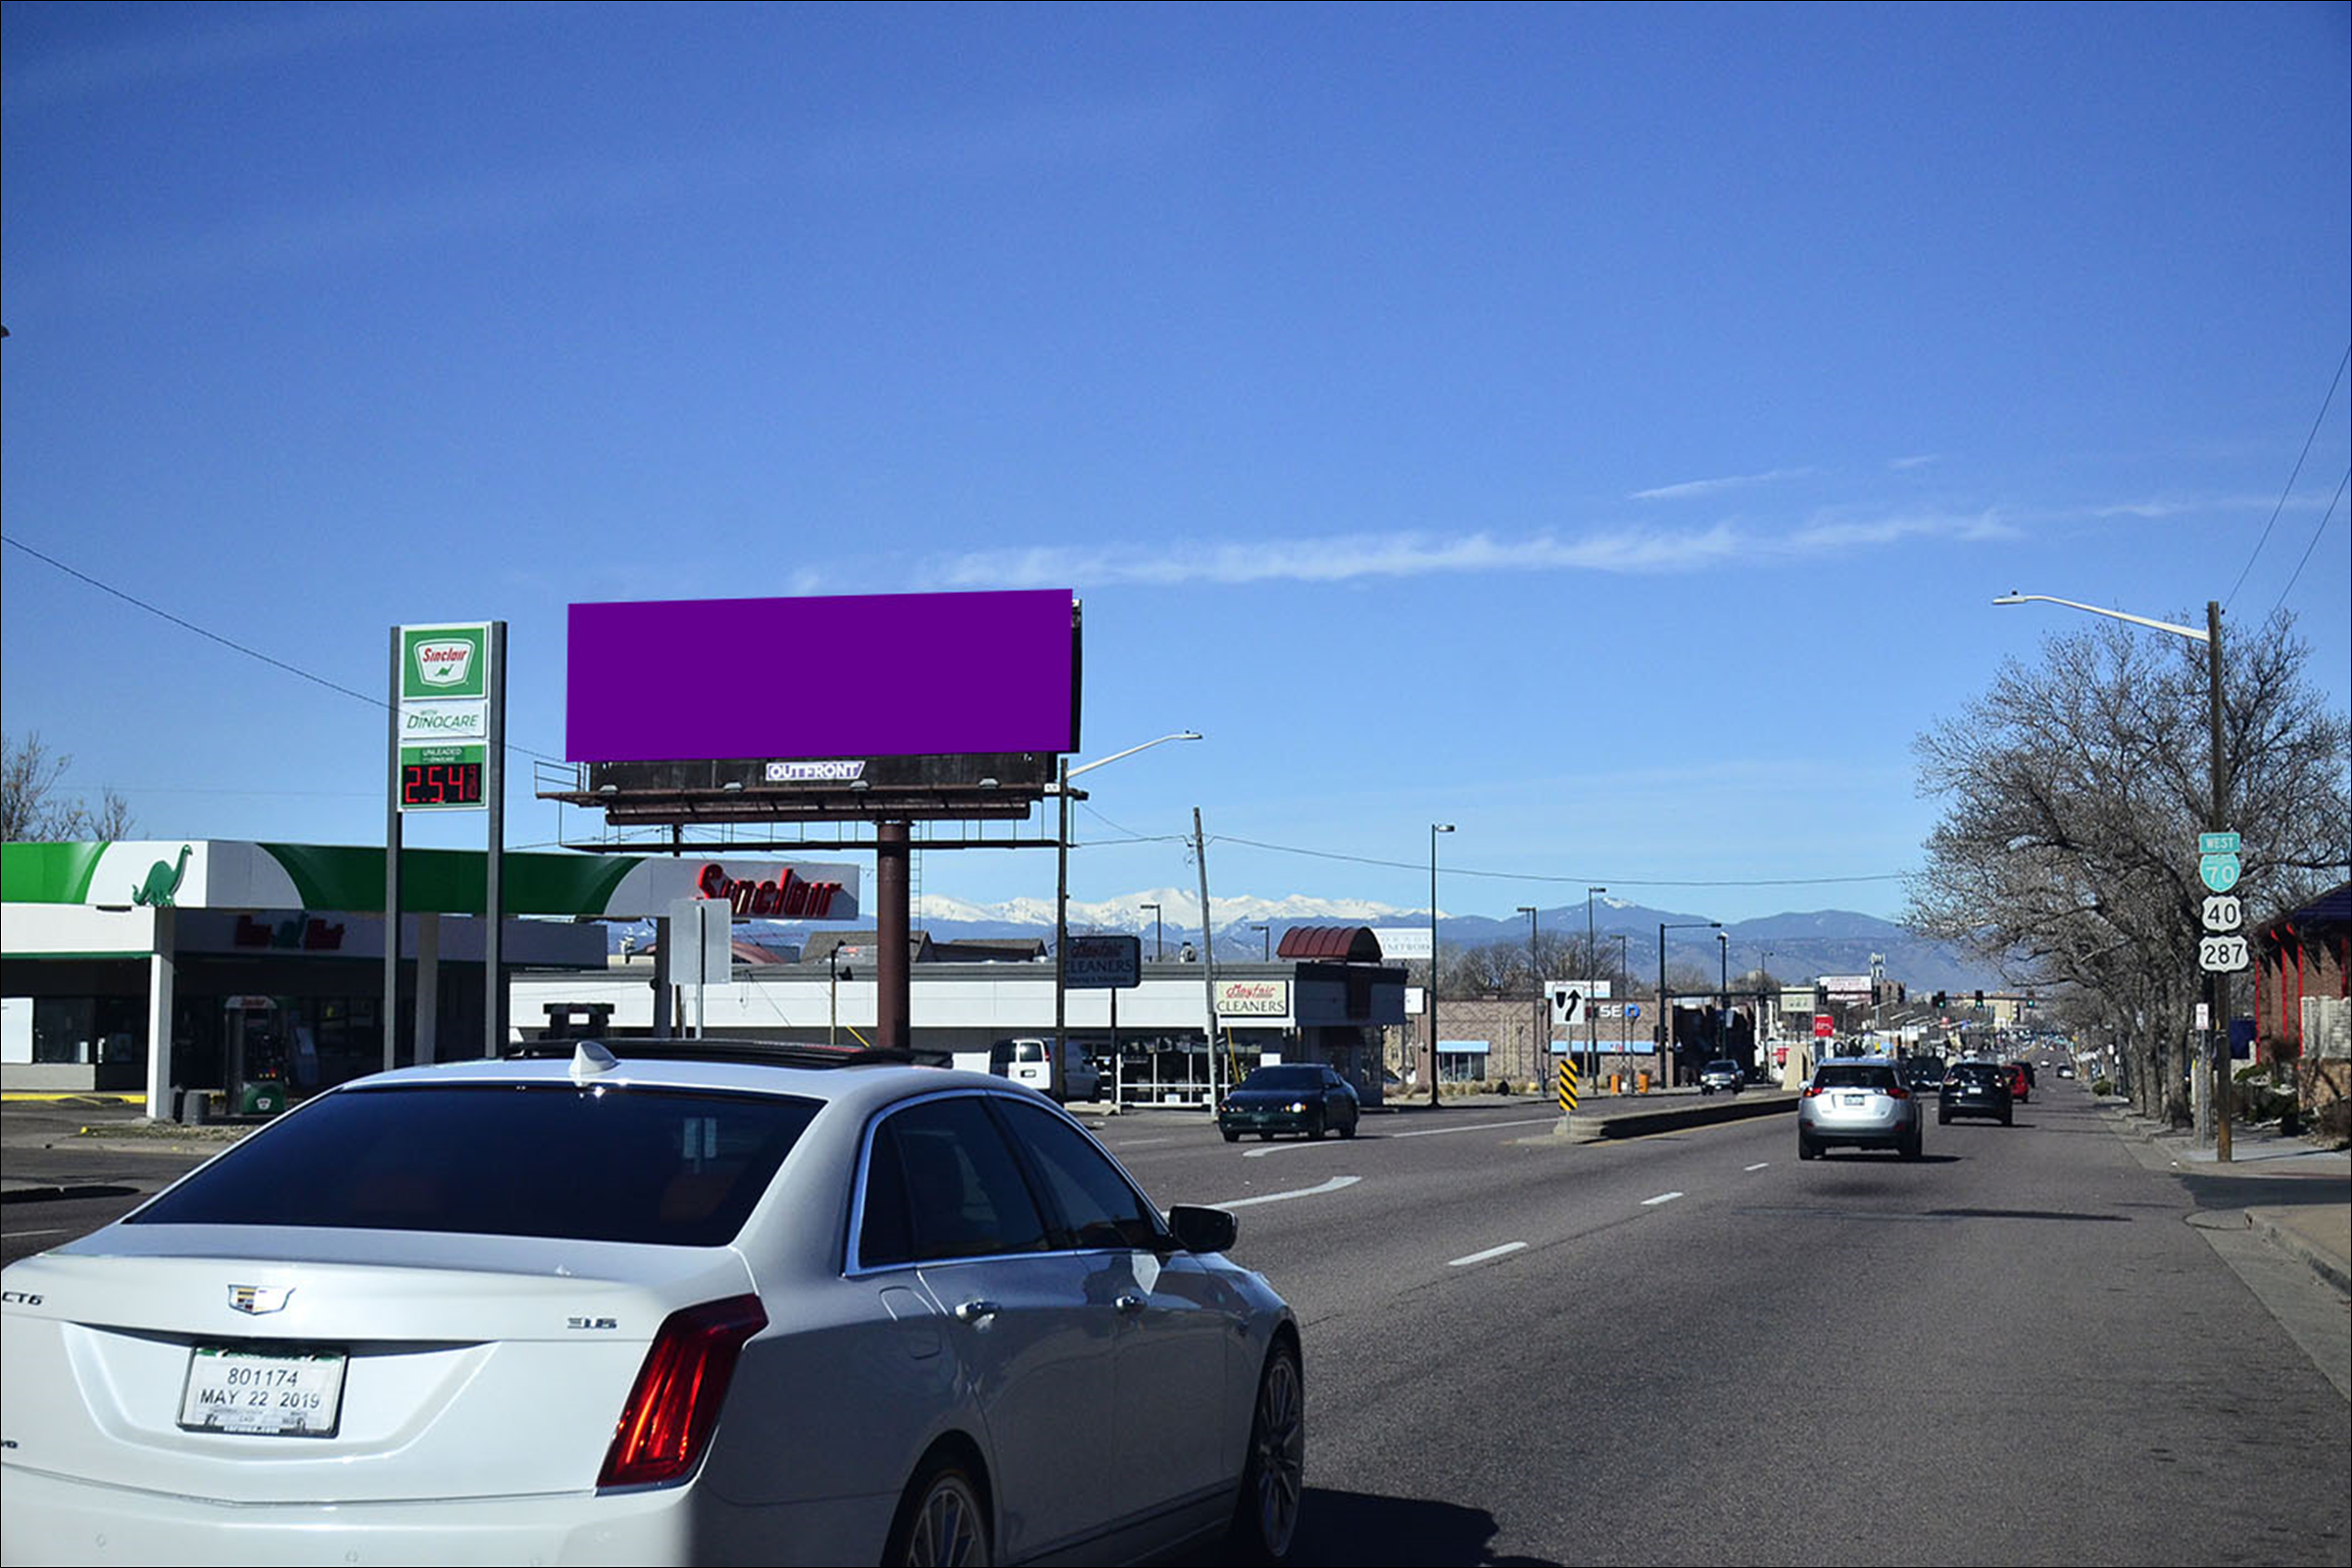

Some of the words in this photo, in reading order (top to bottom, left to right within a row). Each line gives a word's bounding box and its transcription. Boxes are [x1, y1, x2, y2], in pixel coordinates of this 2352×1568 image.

[422, 647, 468, 663] Sinclair
[768, 763, 860, 779] OUTFRONT
[2205, 837, 2234, 850] WEST
[2205, 865, 2235, 885] 70
[698, 863, 843, 916] Sinclair
[2208, 904, 2237, 925] 40
[2204, 943, 2243, 965] 287
[1225, 983, 1277, 999] Mayfair
[1216, 1000, 1286, 1012] CLEANERS
[2, 1291, 45, 1306] CT6
[227, 1367, 299, 1387] 801174
[200, 1389, 240, 1405] MAY
[248, 1391, 270, 1406] 22
[279, 1392, 320, 1409] 2019
